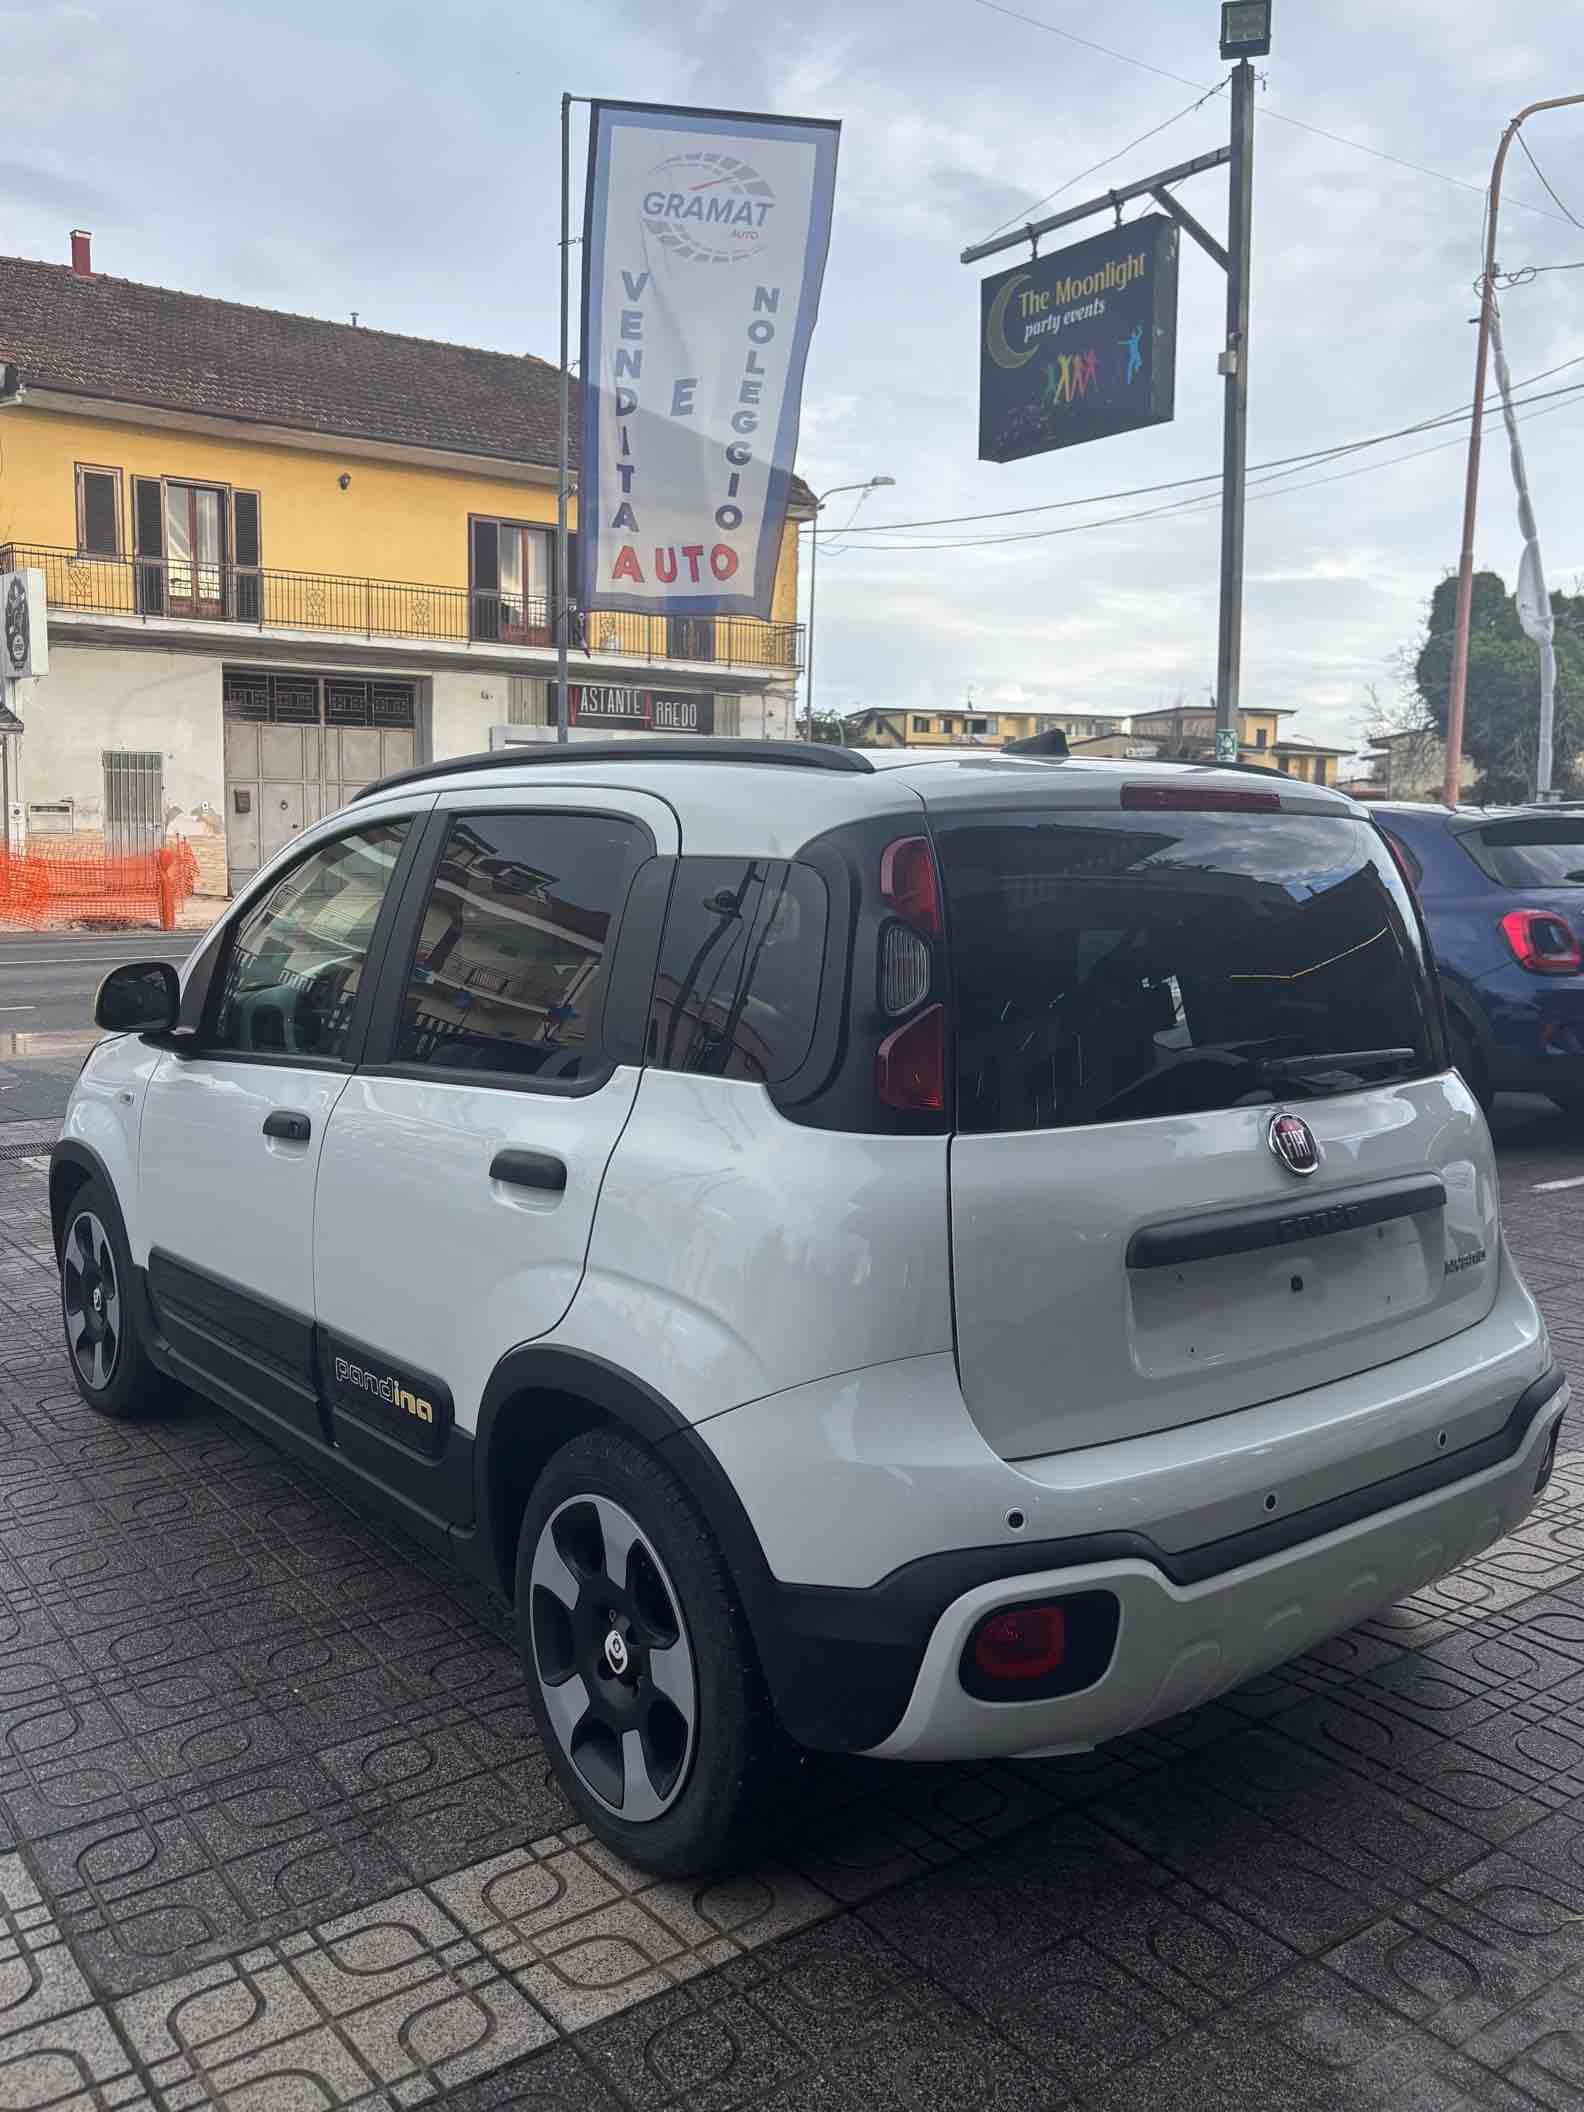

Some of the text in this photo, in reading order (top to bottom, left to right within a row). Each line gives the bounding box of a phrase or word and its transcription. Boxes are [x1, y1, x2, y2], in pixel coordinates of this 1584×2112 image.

[642, 191, 775, 228] GRAMAT
[732, 229, 759, 240] AUTO
[1018, 253, 1145, 317] The Moonlight
[1023, 298, 1105, 343] party events
[611, 270, 649, 534] VENDITA
[671, 378, 697, 417] E
[714, 286, 780, 532] NOLEGGIO
[611, 543, 740, 585] AUTO
[569, 686, 641, 727] VASTANTE
[335, 1357, 433, 1423] pandina
